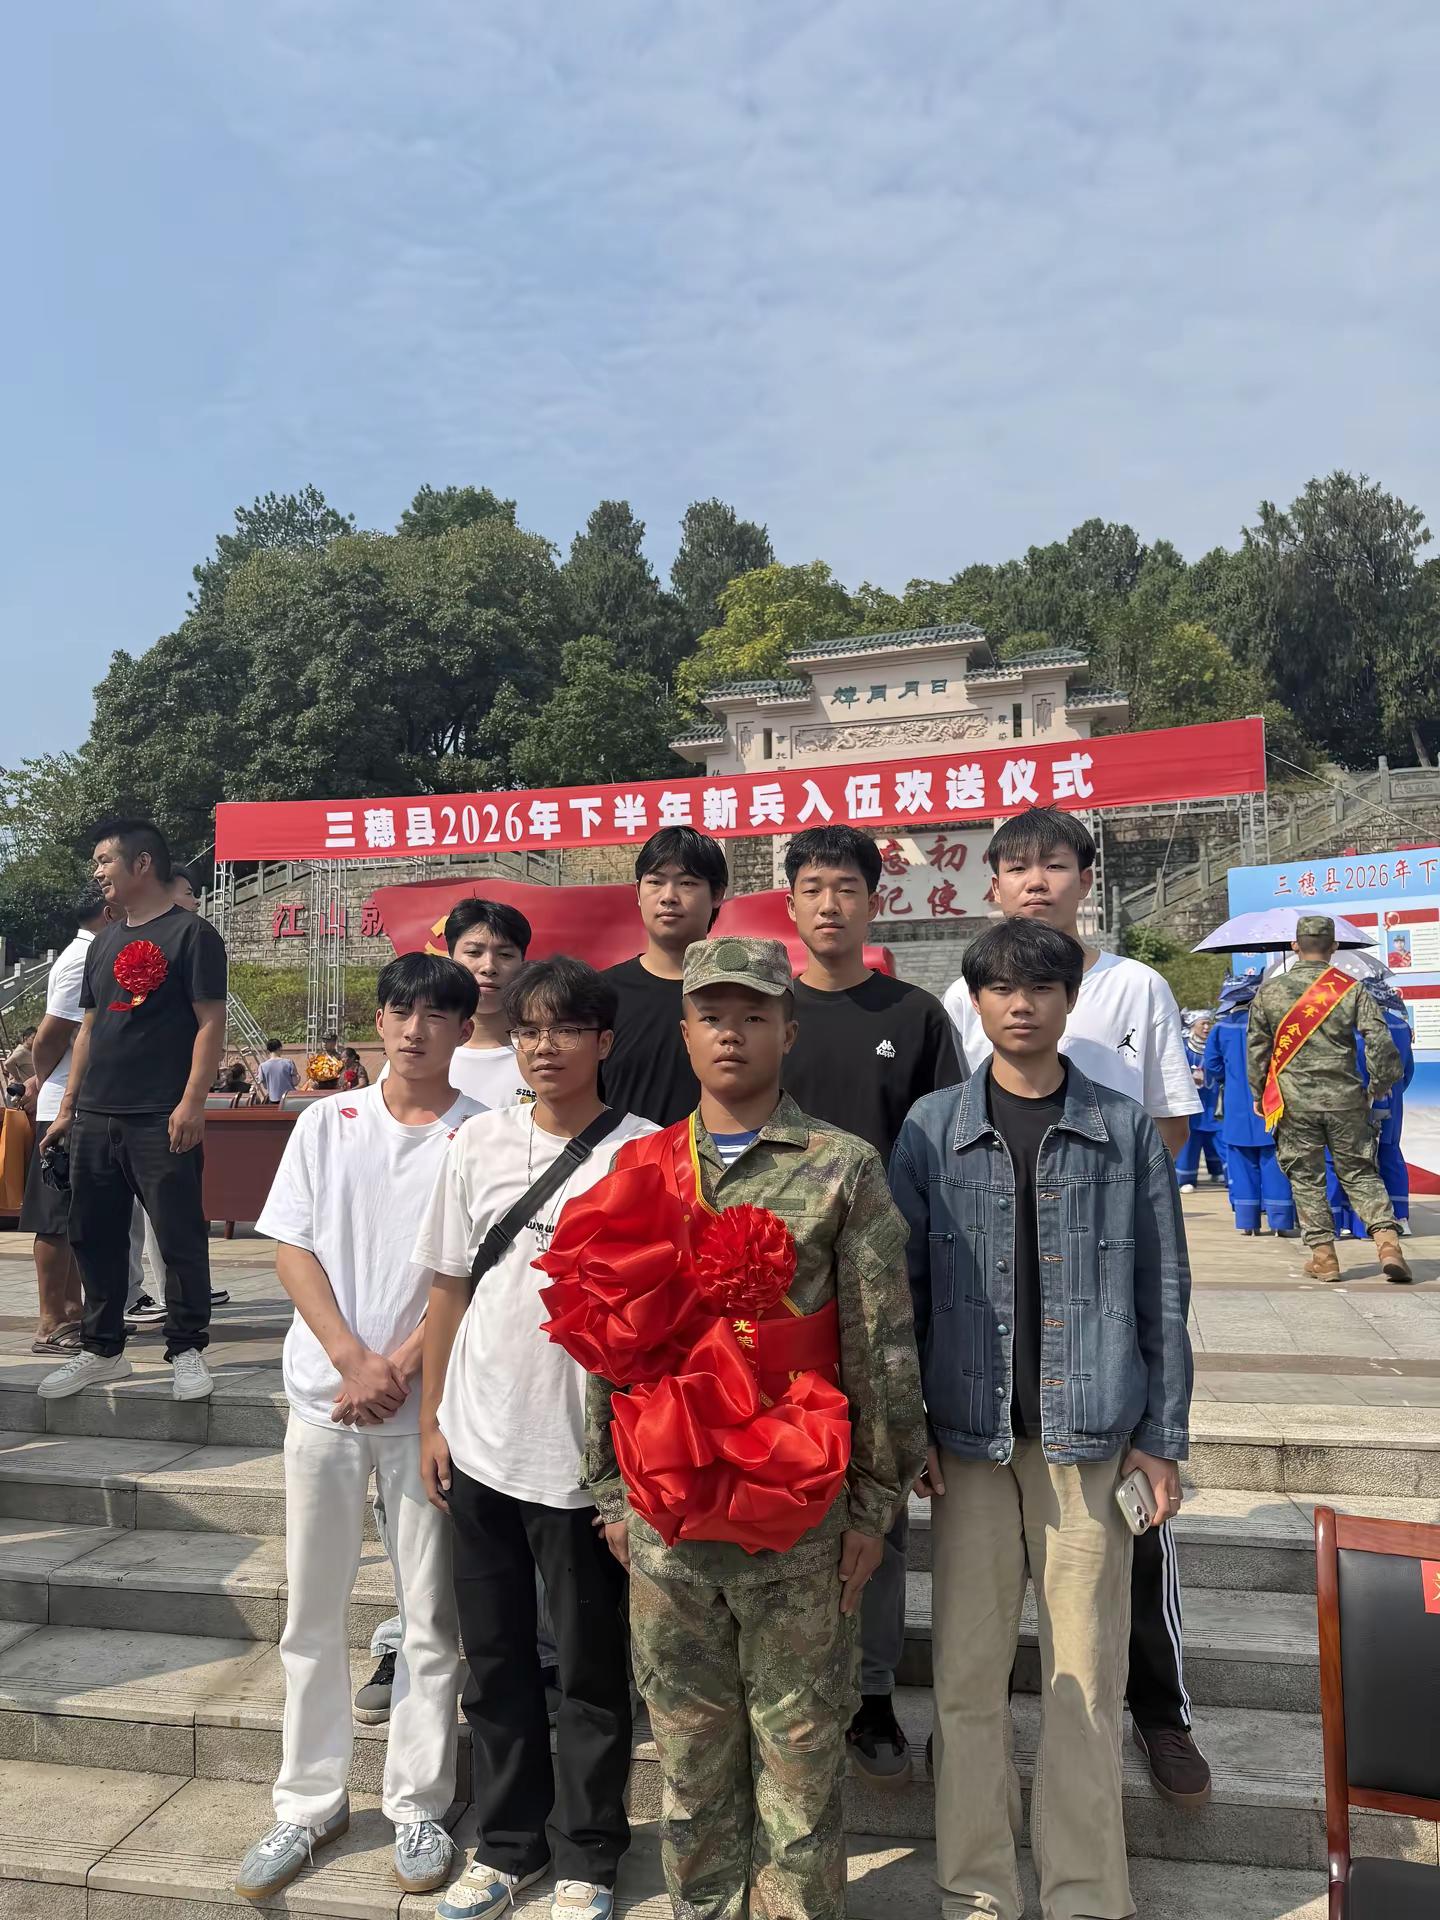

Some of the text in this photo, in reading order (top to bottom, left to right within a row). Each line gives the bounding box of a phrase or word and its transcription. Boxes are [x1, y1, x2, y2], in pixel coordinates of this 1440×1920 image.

[325, 752, 1094, 848] 三穗县2026年下半年新兵入伍欢送仪式
[879, 834, 991, 876] 忘初
[878, 879, 996, 917] 记使
[1273, 859, 1439, 897] 三穗县2026年下
